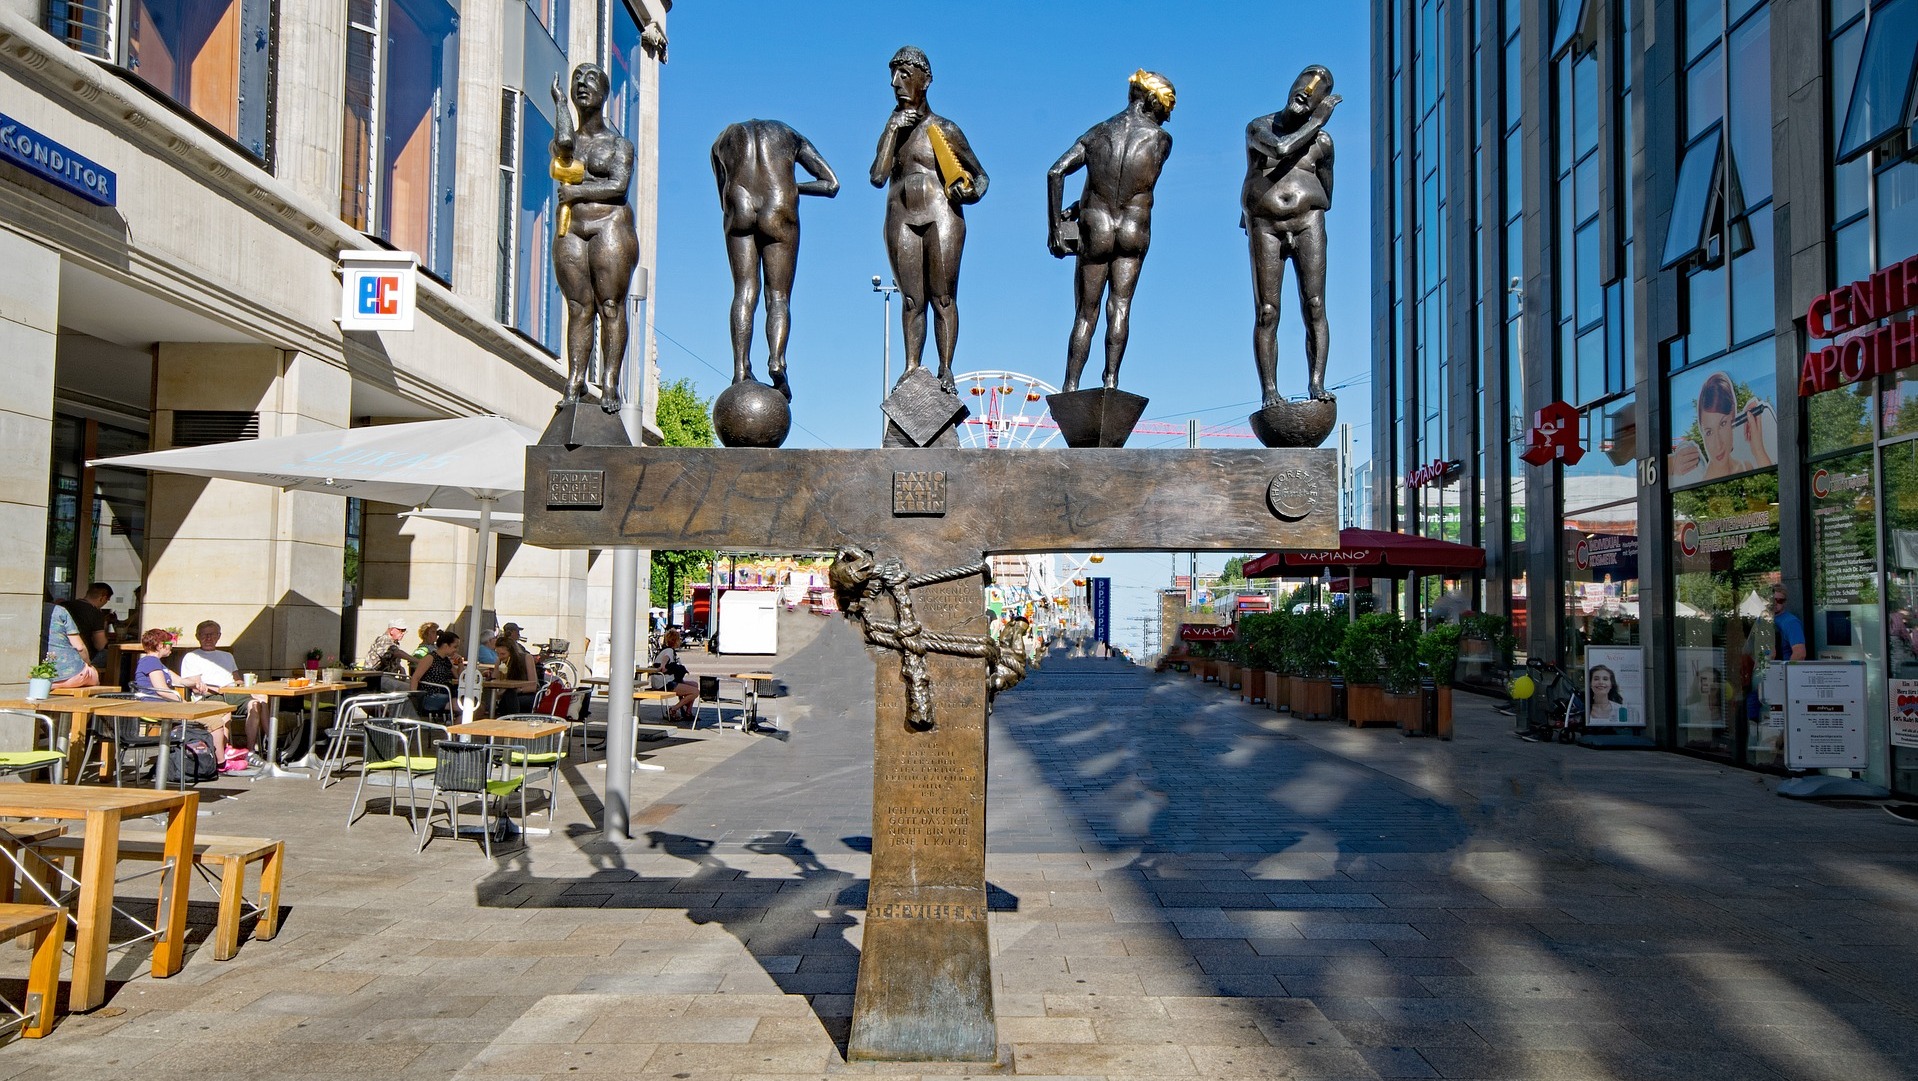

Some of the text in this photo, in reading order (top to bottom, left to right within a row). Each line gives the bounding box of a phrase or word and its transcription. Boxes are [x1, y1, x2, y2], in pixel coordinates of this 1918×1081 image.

[896, 471, 944, 482] RATIO
[1404, 461, 1443, 488] VAPIANO
[1638, 456, 1658, 487] 16
[551, 493, 598, 502] KERIN
[896, 501, 944, 511] KERIN
[1723, 533, 1748, 551] HAUT
[887, 806, 970, 817] ICH DANKE DIR
[921, 816, 946, 826] DASS
[949, 816, 969, 827] ICH
[888, 826, 967, 837] NICHT BIN WIE
[889, 837, 915, 847] JENE
